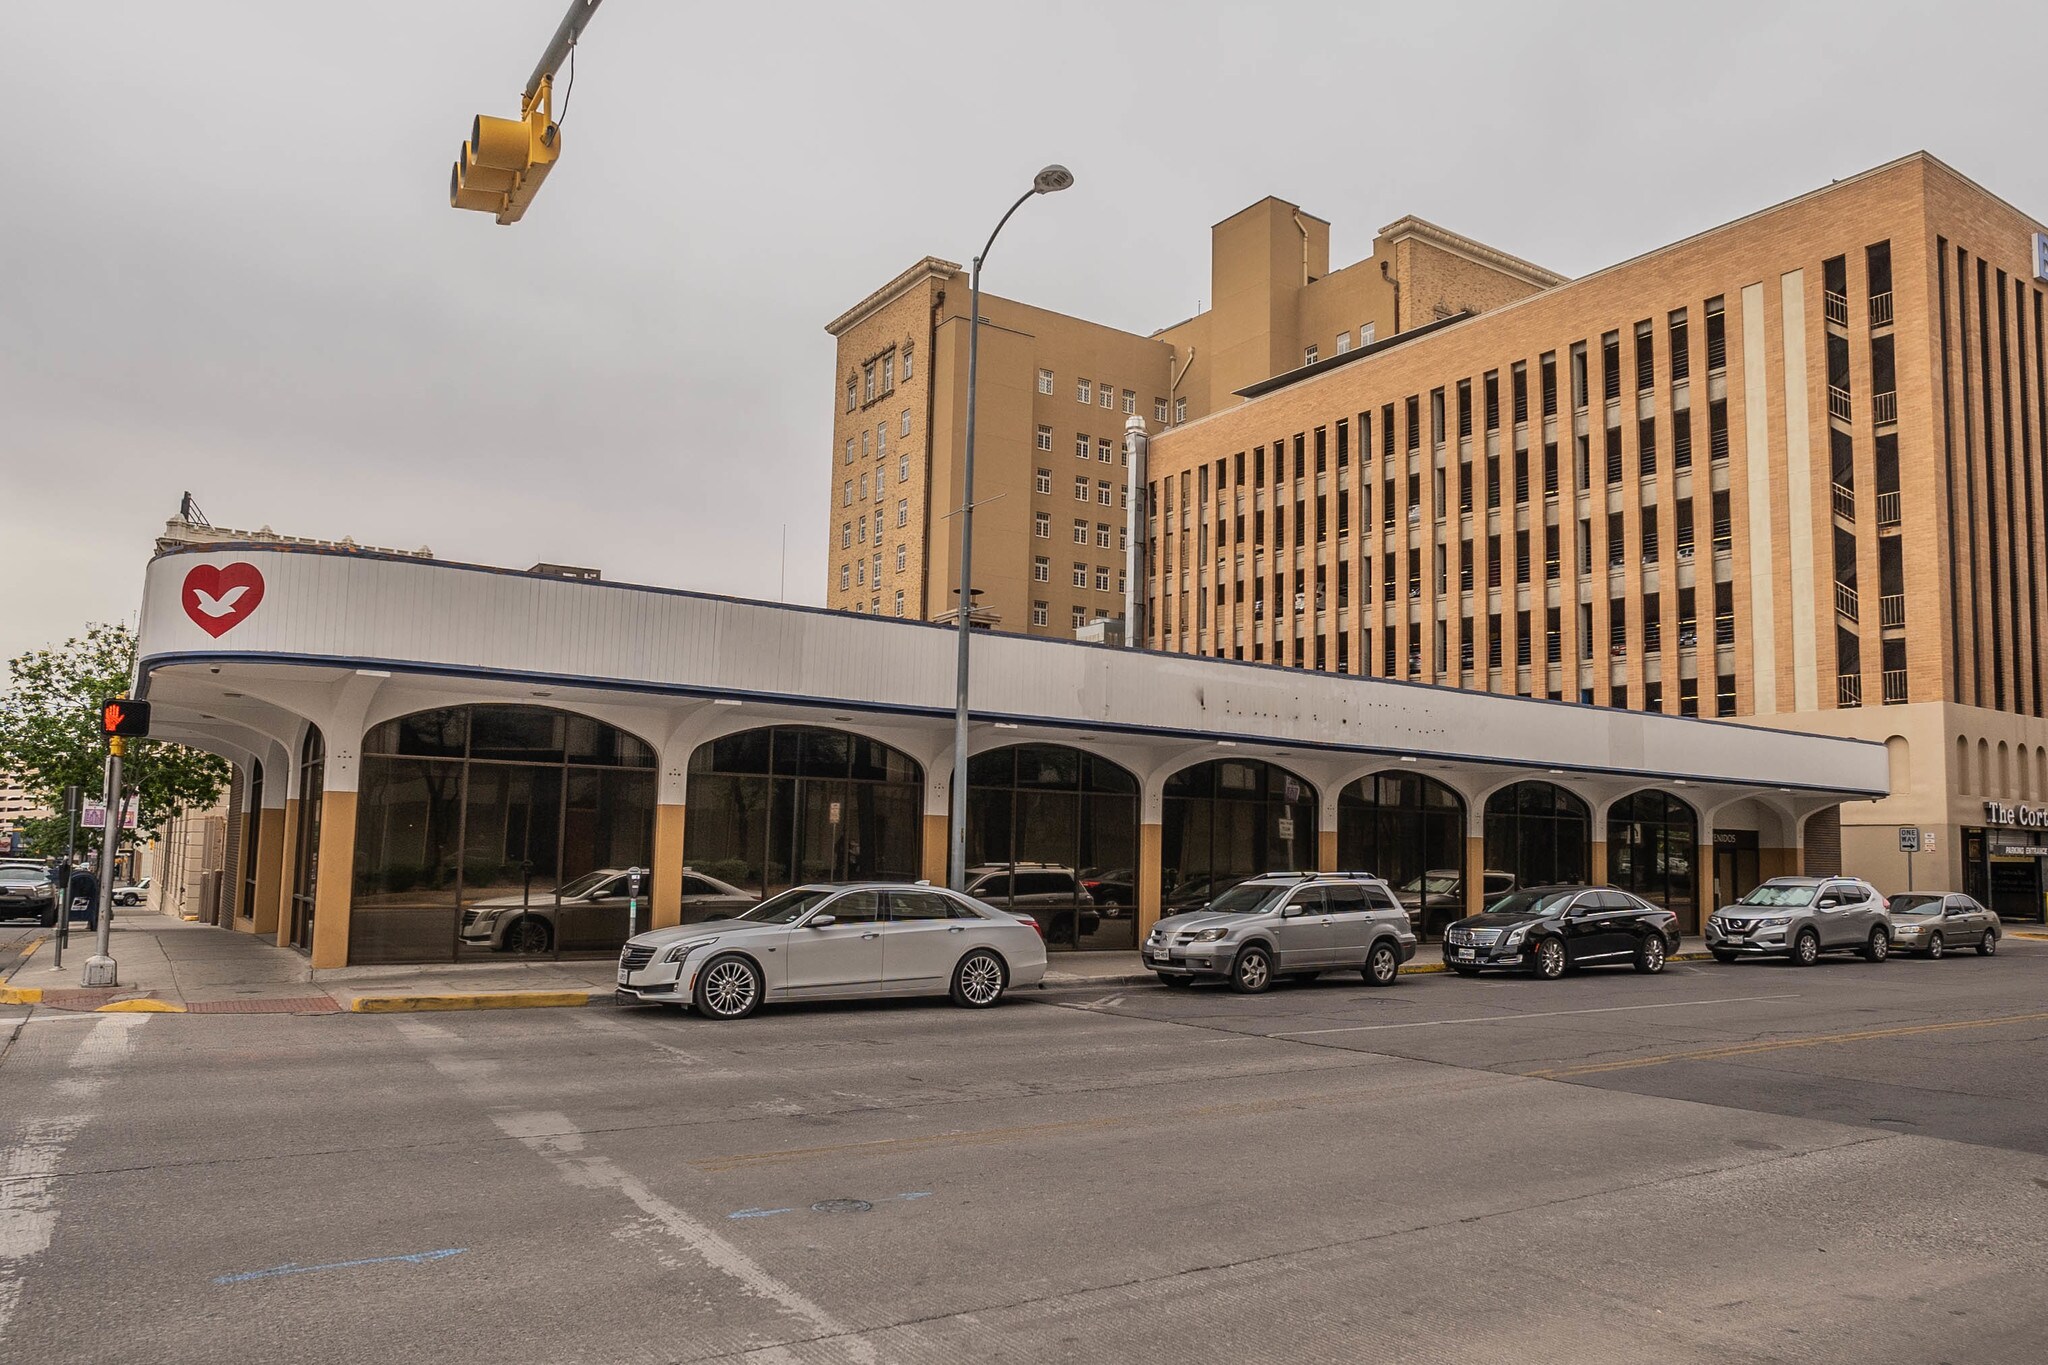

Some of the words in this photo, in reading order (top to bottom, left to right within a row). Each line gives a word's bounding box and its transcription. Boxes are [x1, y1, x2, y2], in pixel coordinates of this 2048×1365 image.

[1989, 802, 2015, 825] The
[2005, 846, 2024, 854] PARKING
[2025, 847, 2048, 855] ENTRANCE
